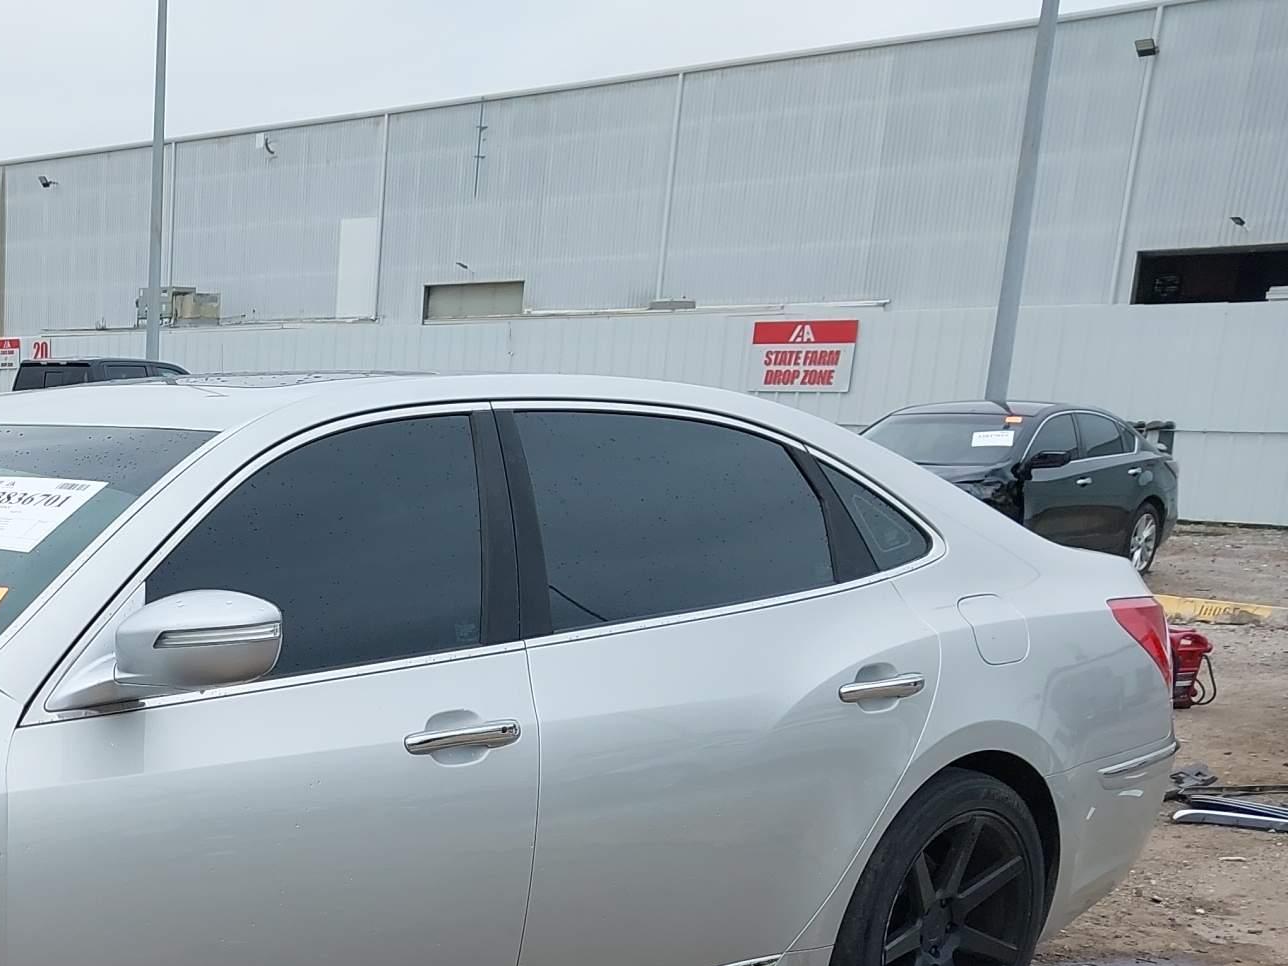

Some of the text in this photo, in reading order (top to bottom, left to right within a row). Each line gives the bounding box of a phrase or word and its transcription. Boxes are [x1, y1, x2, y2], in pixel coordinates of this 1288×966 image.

[33, 341, 49, 359] 20
[764, 350, 840, 366] STATE FARM
[763, 369, 835, 386] DROP ZONE
